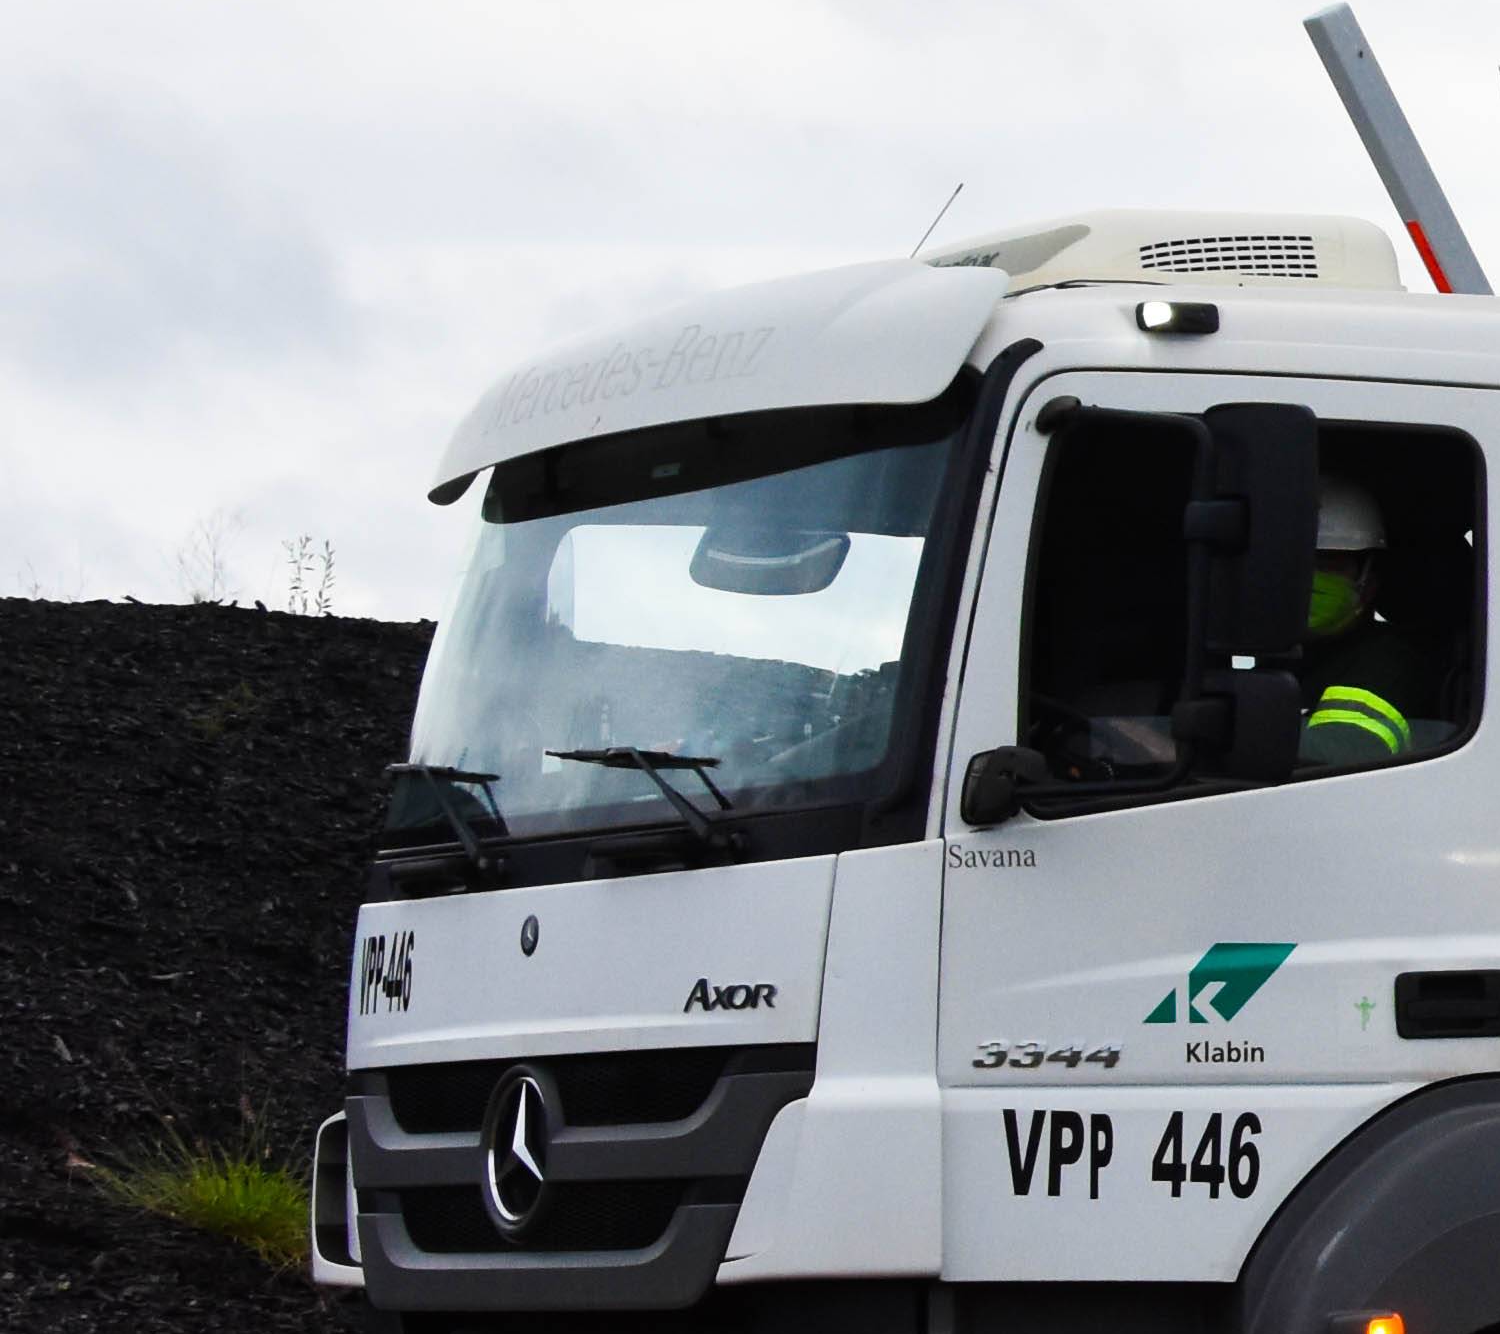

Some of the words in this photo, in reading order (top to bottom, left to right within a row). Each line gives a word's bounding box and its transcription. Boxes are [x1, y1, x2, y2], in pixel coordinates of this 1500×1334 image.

[488, 324, 776, 431] Mercedes-Benz
[948, 844, 1037, 868] Savana
[360, 930, 414, 1016] VPP-446
[971, 1038, 1125, 1069] 3344
[1185, 1040, 1265, 1064] Klabin
[1002, 1108, 1113, 1199] VPP
[1151, 1110, 1262, 1199] 446
